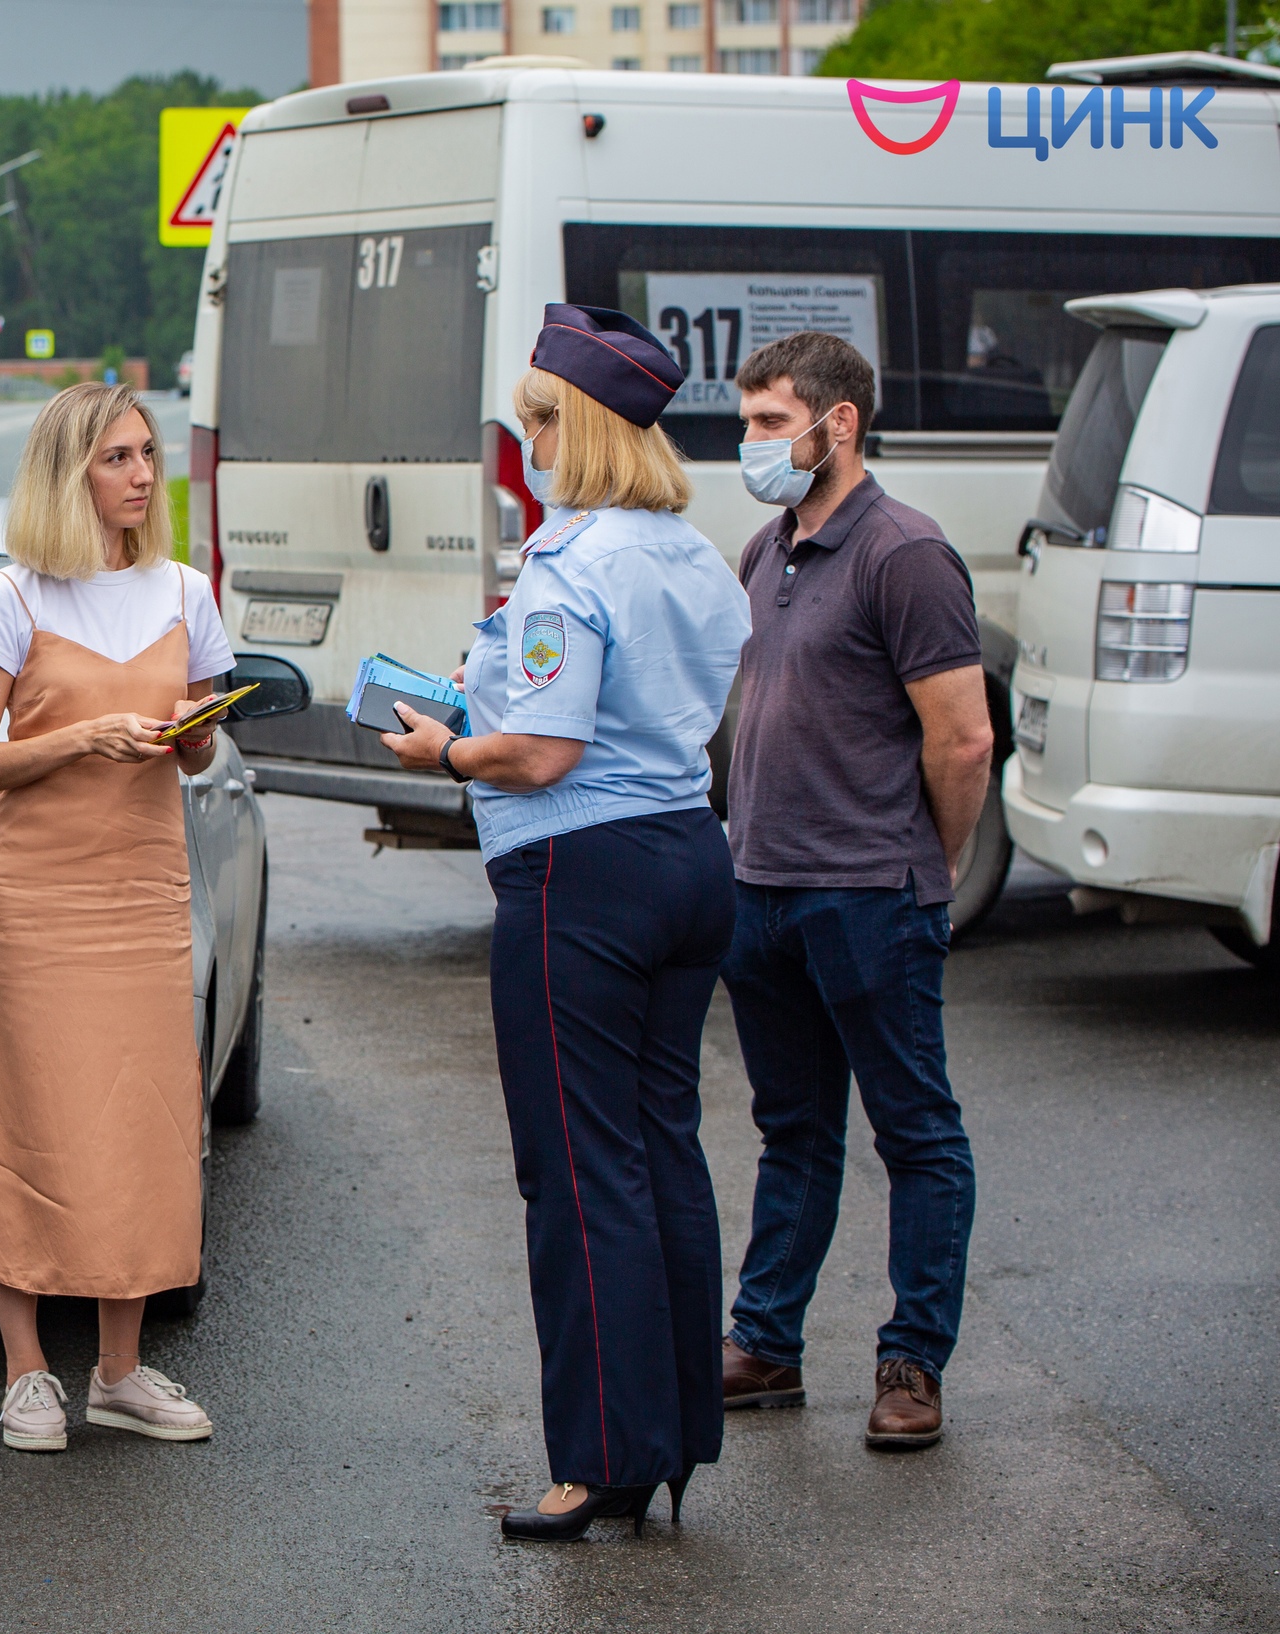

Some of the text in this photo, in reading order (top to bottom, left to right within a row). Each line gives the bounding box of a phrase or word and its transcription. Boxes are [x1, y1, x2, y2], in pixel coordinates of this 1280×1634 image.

[358, 236, 404, 290] 317
[660, 306, 742, 381] 317
[228, 530, 289, 546] PEUGEOT
